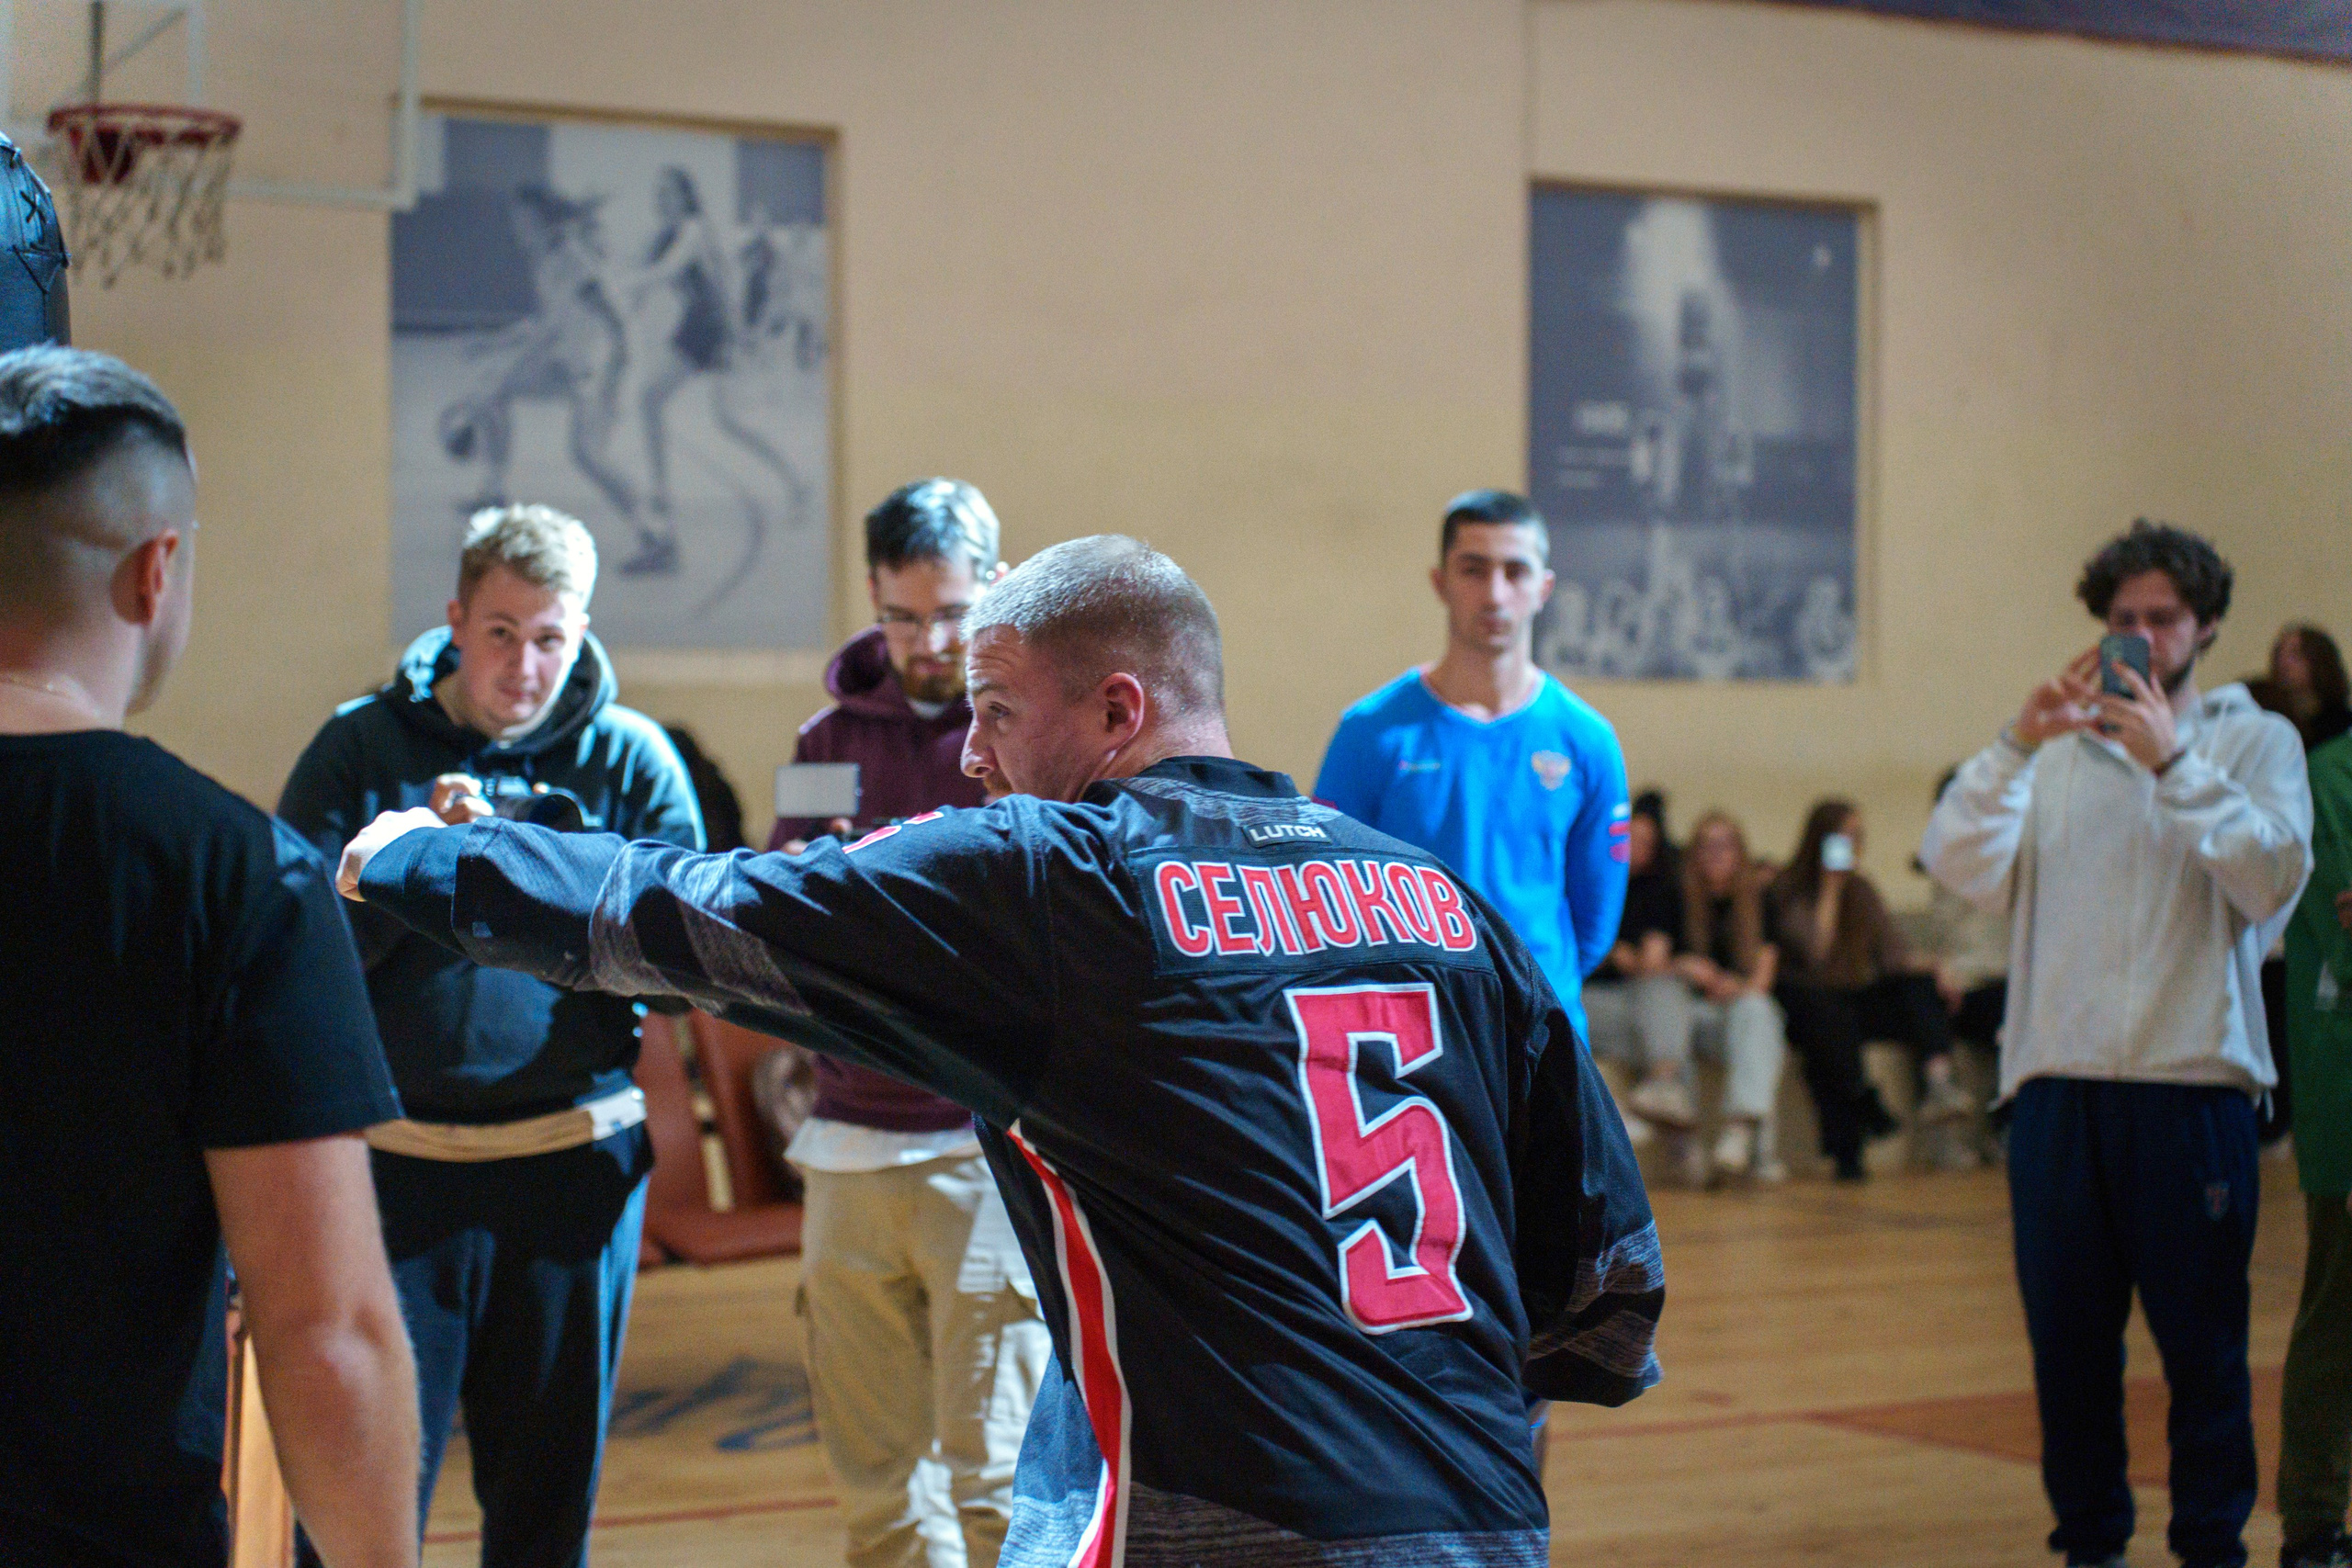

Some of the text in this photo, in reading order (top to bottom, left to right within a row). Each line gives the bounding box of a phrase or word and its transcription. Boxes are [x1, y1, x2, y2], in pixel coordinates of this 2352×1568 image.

[1250, 825, 1326, 841] LUTCH
[1154, 860, 1477, 956] СЕЛЮКОВ
[1283, 983, 1474, 1335] 5
